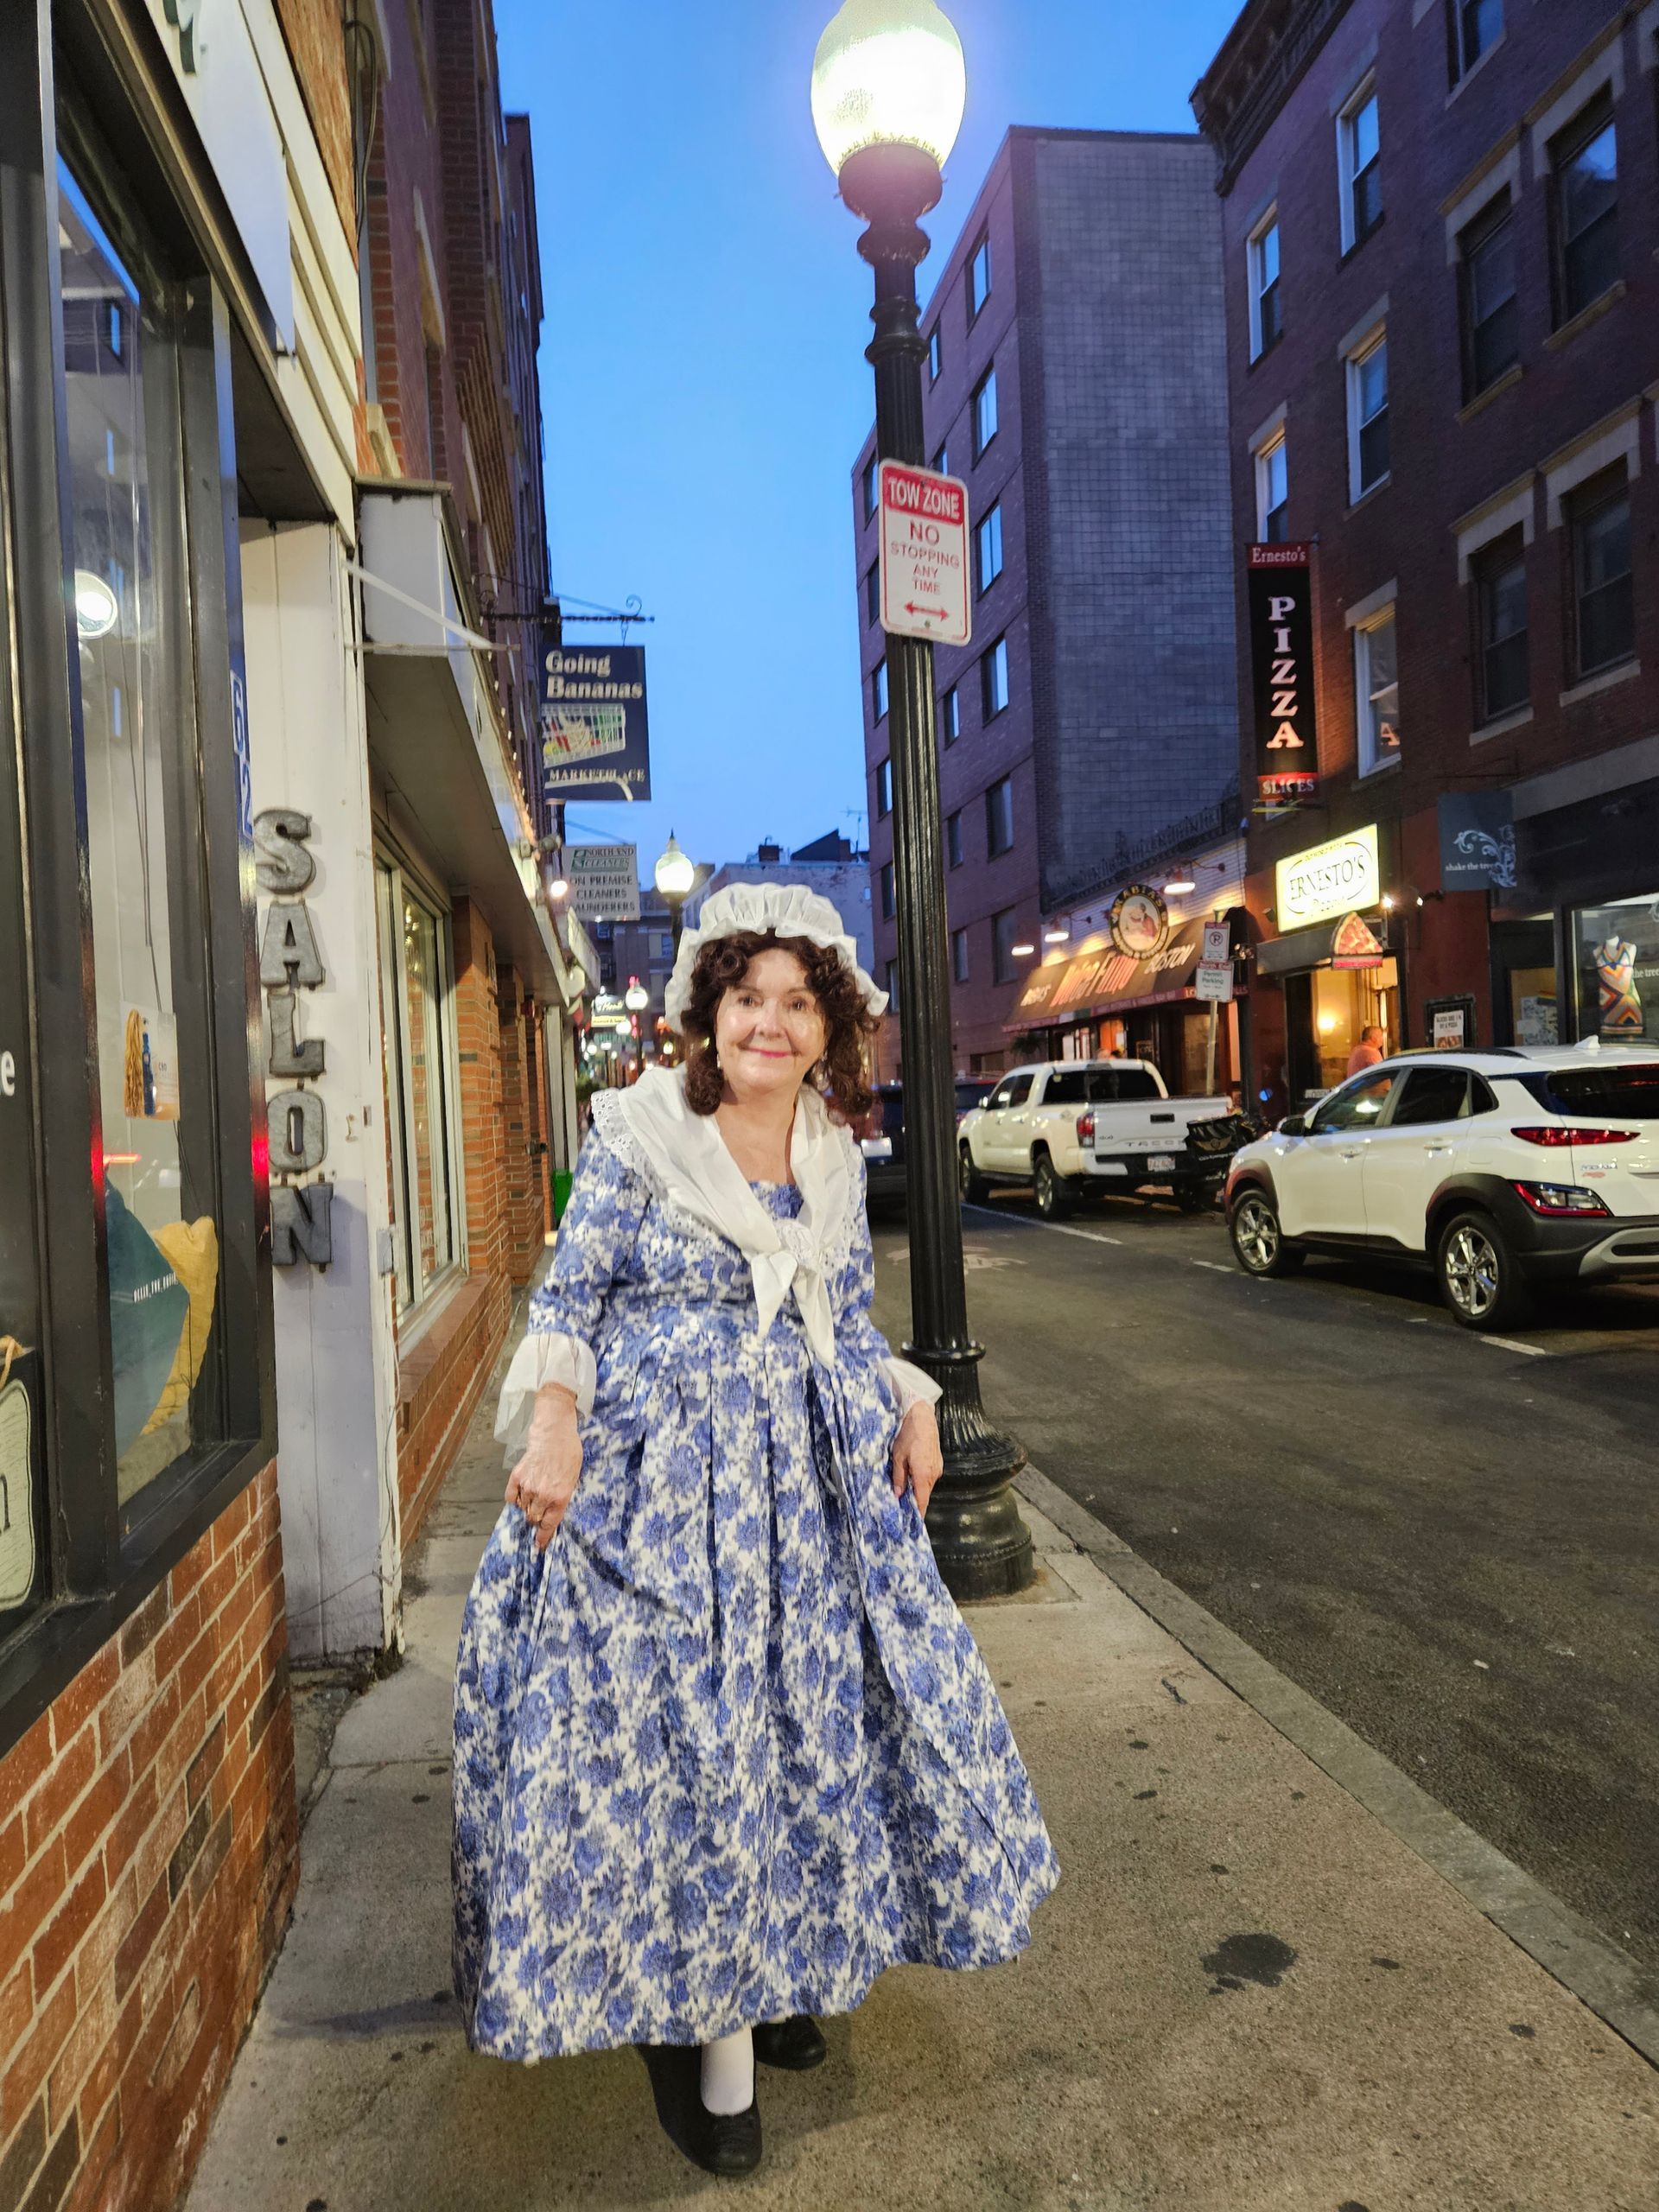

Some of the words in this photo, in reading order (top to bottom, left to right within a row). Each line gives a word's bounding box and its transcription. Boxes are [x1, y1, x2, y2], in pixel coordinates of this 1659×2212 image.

[887, 476, 921, 509] TOW
[923, 486, 960, 520] ZONE
[910, 519, 940, 546] NO
[890, 540, 960, 569] STOPPING
[1252, 545, 1306, 563] Ernesto's
[912, 563, 938, 579] ANY
[912, 576, 941, 594] TIME
[545, 650, 611, 677] Going
[1266, 595, 1305, 749] PIZZA
[547, 674, 643, 699] Bananas
[1262, 779, 1314, 794] SLICES
[587, 849, 613, 857] NORTH
[1446, 862, 1465, 871] shake
[589, 874, 632, 886] PREMISE
[1290, 855, 1365, 900] ERNESTO'S
[576, 888, 627, 899] CLEANERS
[574, 901, 635, 912] AUNDERERS
[253, 809, 334, 1268] SALON
